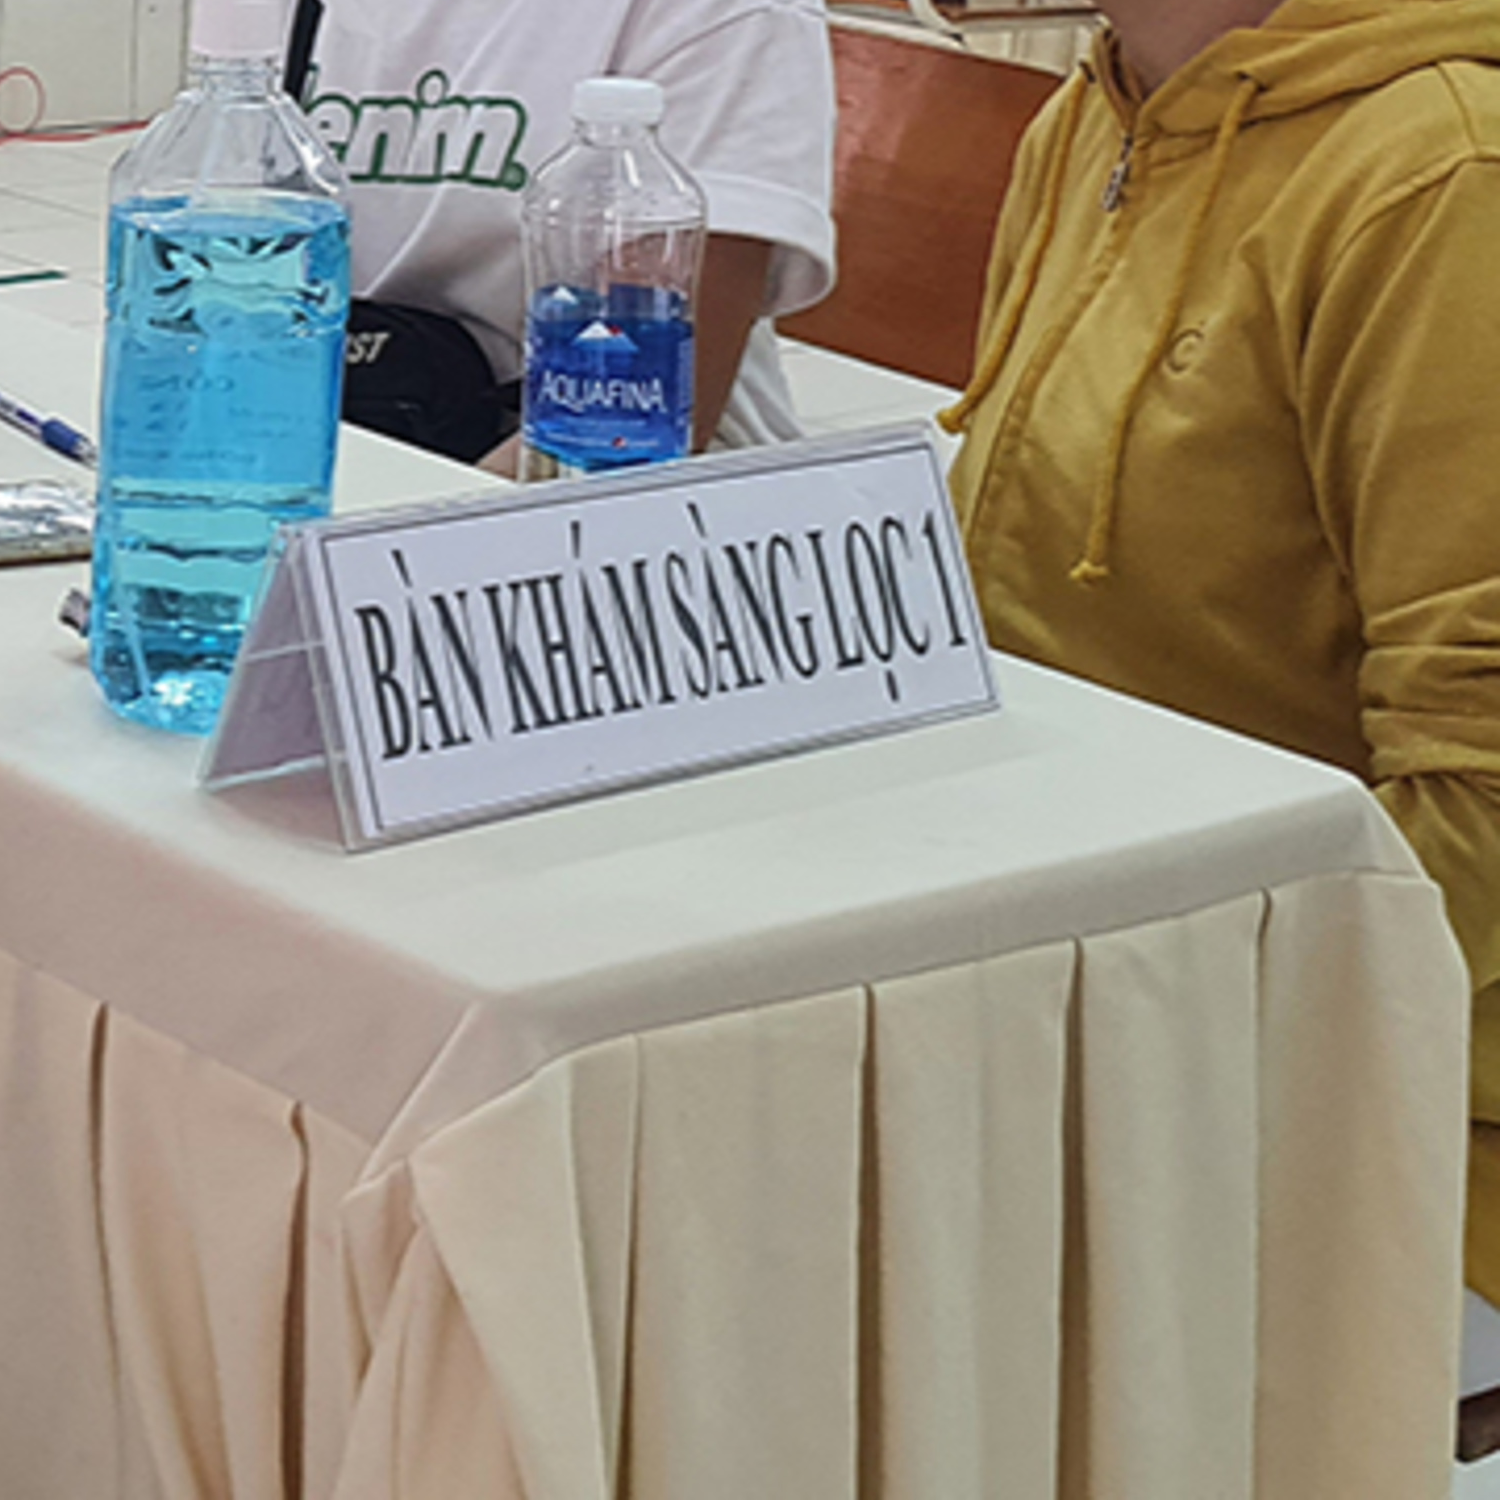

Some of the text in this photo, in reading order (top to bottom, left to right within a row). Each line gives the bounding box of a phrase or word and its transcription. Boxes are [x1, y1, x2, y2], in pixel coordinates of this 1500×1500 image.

[344, 331, 391, 363] ST
[536, 369, 668, 414] AQUAFINA
[354, 501, 967, 760] BÀN KHÁM SÀNG LỌC 1
